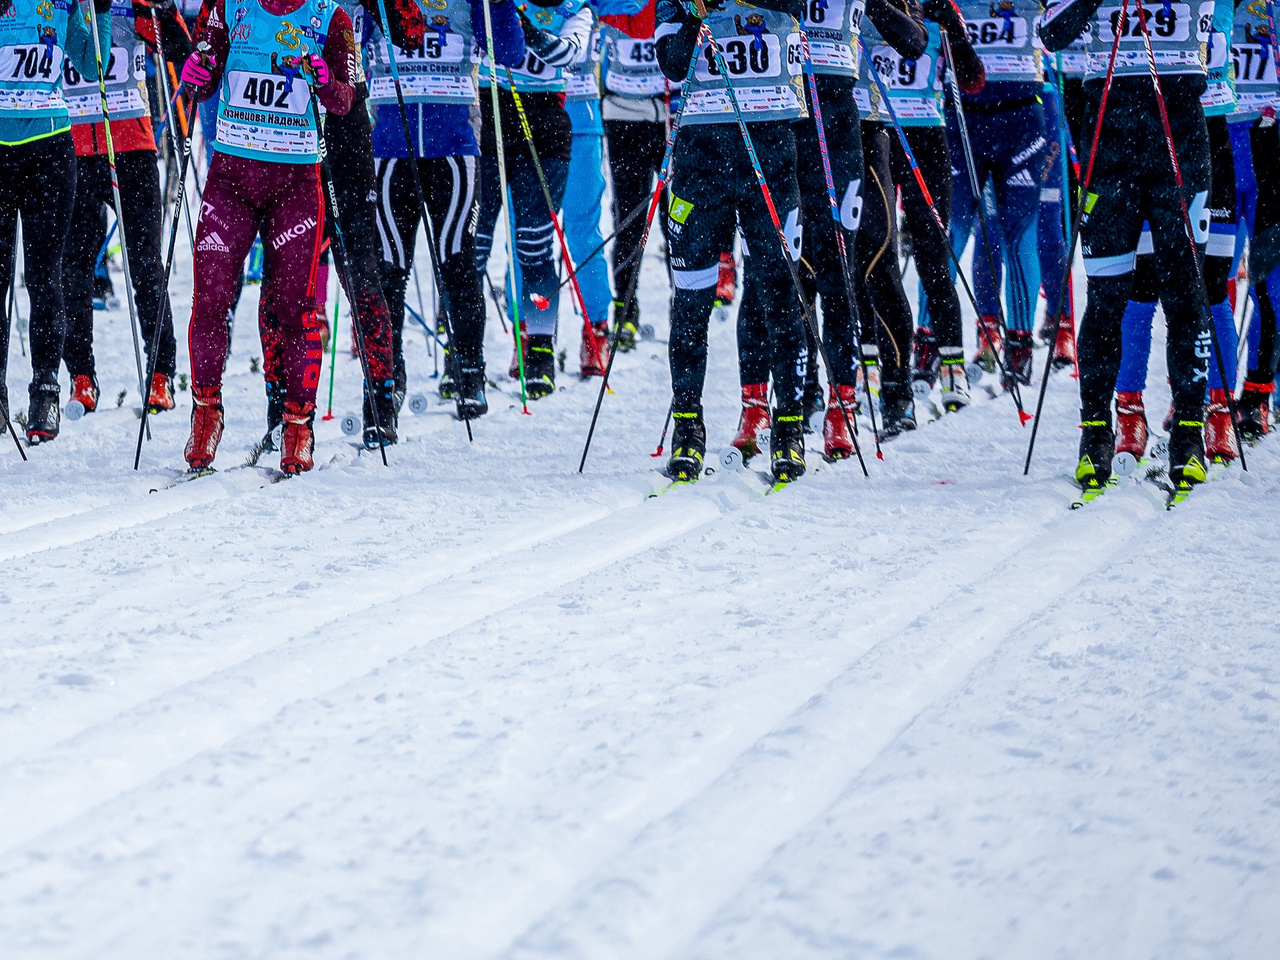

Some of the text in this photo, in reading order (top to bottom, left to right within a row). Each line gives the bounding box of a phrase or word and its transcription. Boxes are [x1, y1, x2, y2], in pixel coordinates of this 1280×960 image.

[275, 21, 305, 50] 25
[1109, 8, 1177, 38] 629
[11, 46, 52, 79] 704
[64, 50, 117, 86] 62
[704, 40, 770, 76] 630
[243, 77, 290, 109] 402
[196, 243, 230, 254] adidas
[272, 216, 318, 251] LUKOIL
[345, 418, 354, 431] 9
